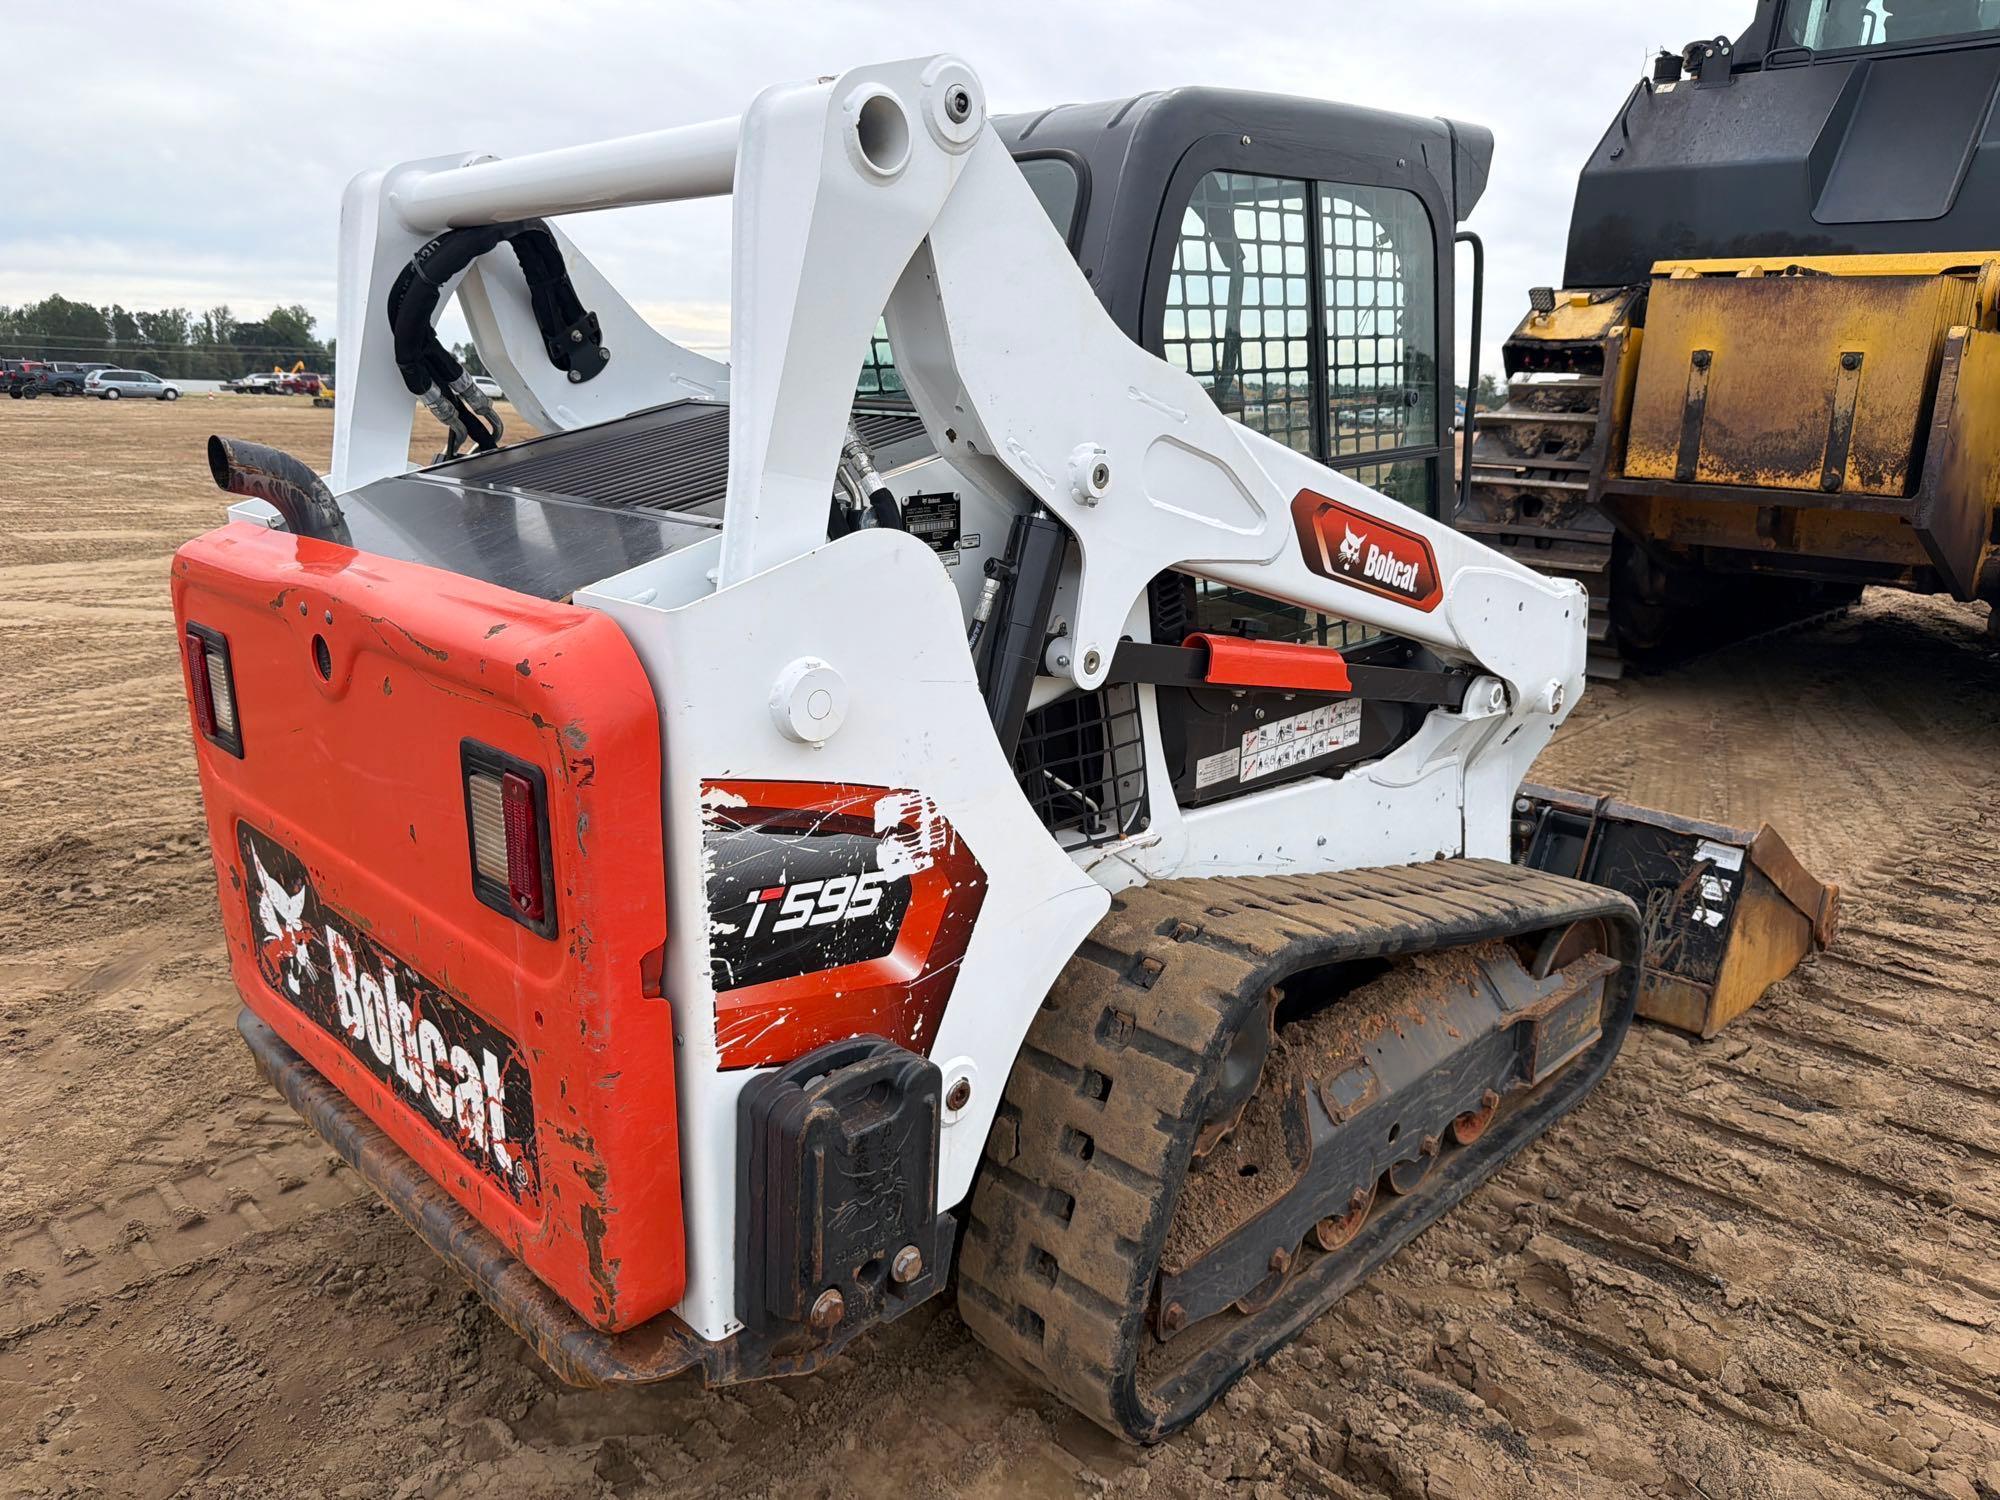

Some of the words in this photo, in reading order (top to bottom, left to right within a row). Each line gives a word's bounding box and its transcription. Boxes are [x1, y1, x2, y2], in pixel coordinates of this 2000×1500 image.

[1363, 543, 1419, 592] Bobcat
[743, 872, 888, 938] T595
[325, 923, 513, 1175] Bobcat
